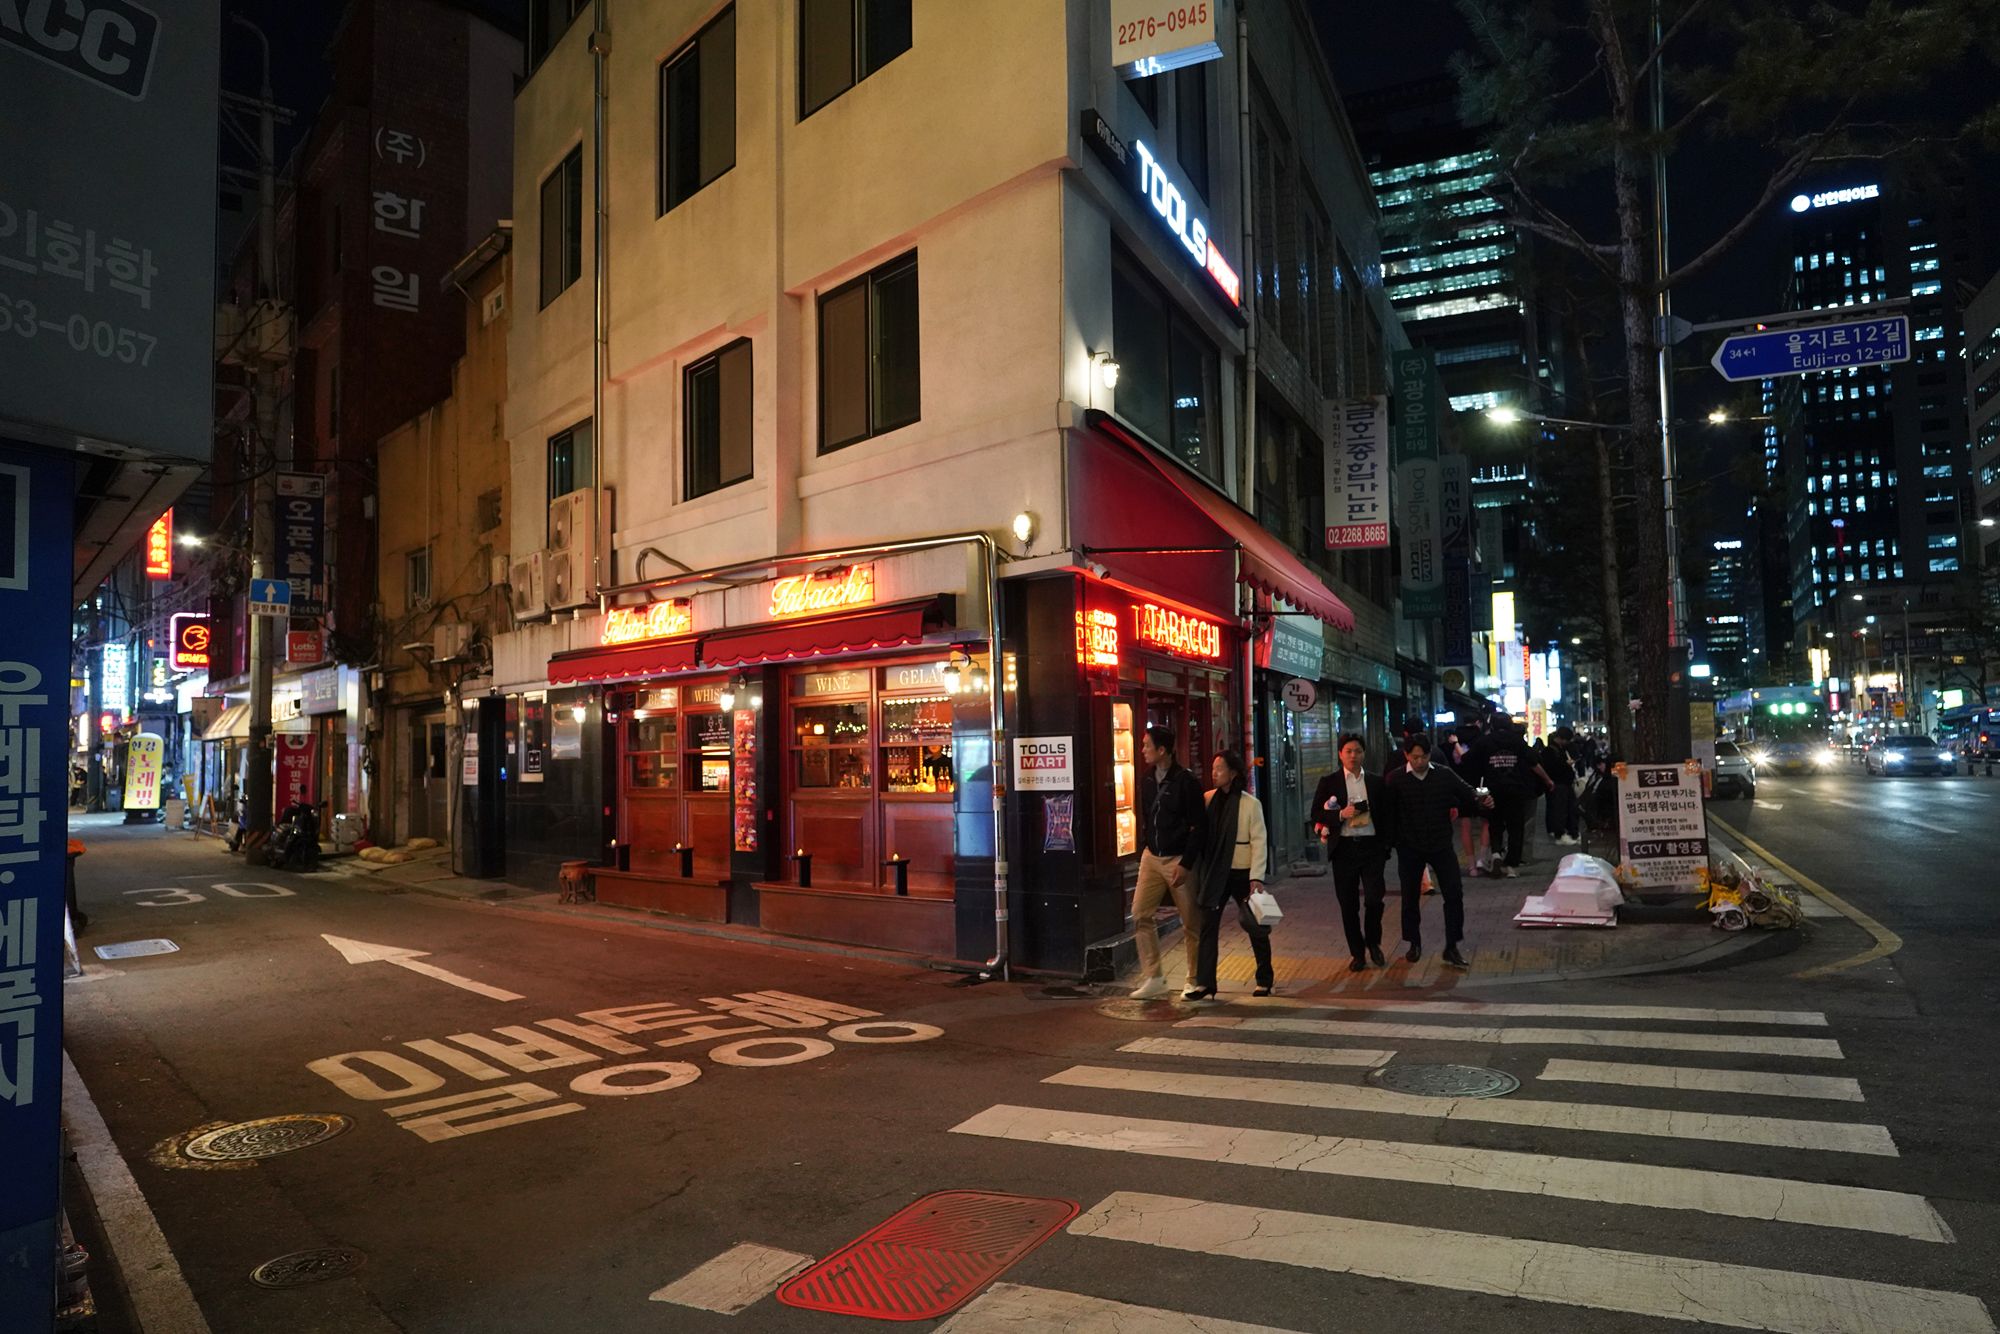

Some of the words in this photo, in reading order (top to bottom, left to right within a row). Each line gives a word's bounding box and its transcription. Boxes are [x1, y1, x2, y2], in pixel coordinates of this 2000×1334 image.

[1119, 3, 1207, 45] 2276-0945
[375, 126, 426, 169] (주)
[1136, 139, 1207, 268] TOOLS
[1812, 184, 1880, 209] 신한라이프
[371, 190, 426, 313] 한일
[1785, 321, 1902, 354] 을지로12길
[1792, 352, 1852, 369] Eulji-ro
[1856, 344, 1902, 361] 12-gil
[1328, 526, 1387, 546] 02.2268.8665
[768, 564, 869, 616] Tabacchi
[601, 609, 648, 645] Gelato
[648, 602, 686, 637] Bar
[1144, 603, 1220, 658] TABACCHI
[292, 641, 316, 651] Lotto
[1094, 625, 1118, 653] BAR
[816, 675, 851, 692] WINE
[1287, 683, 1310, 707] 간판
[1019, 743, 1067, 755] TOOLS
[1022, 756, 1065, 768] MART
[136, 753, 156, 806] 노래방
[1644, 770, 1674, 785] 경고
[1625, 791, 1650, 800] 쓰레기
[1653, 788, 1697, 799] 무단투기는
[1626, 801, 1699, 814] 범죄행위입니다.
[1633, 843, 1662, 855] CCTV
[1666, 841, 1702, 855] 촬영중
[122, 882, 297, 907] 30
